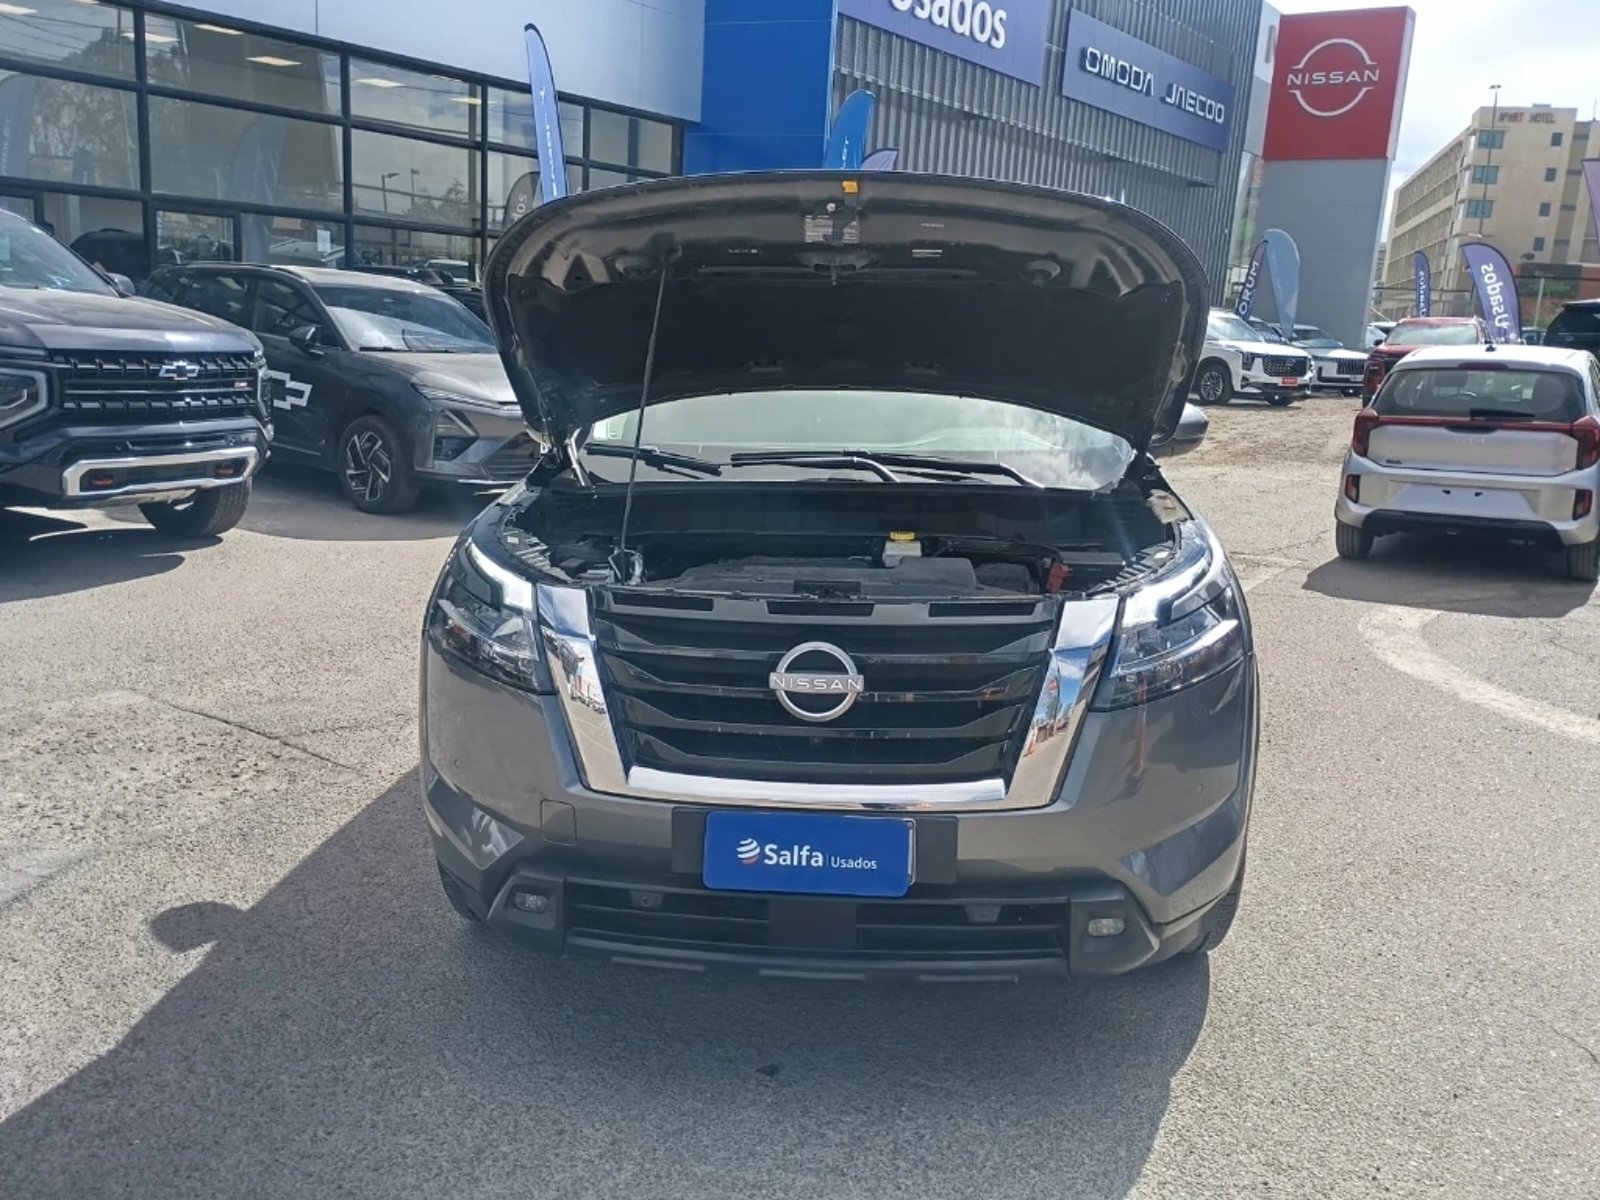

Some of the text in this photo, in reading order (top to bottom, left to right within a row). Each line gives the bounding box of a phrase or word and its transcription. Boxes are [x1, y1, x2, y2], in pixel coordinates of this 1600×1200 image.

[891, 0, 1008, 49] sados
[1085, 47, 1225, 124] OMODA JAECOO
[1287, 69, 1379, 86] NISSAN
[1239, 261, 1260, 315] ORUM
[772, 675, 861, 690] NISSAN
[764, 843, 878, 870] Salfa Usados
